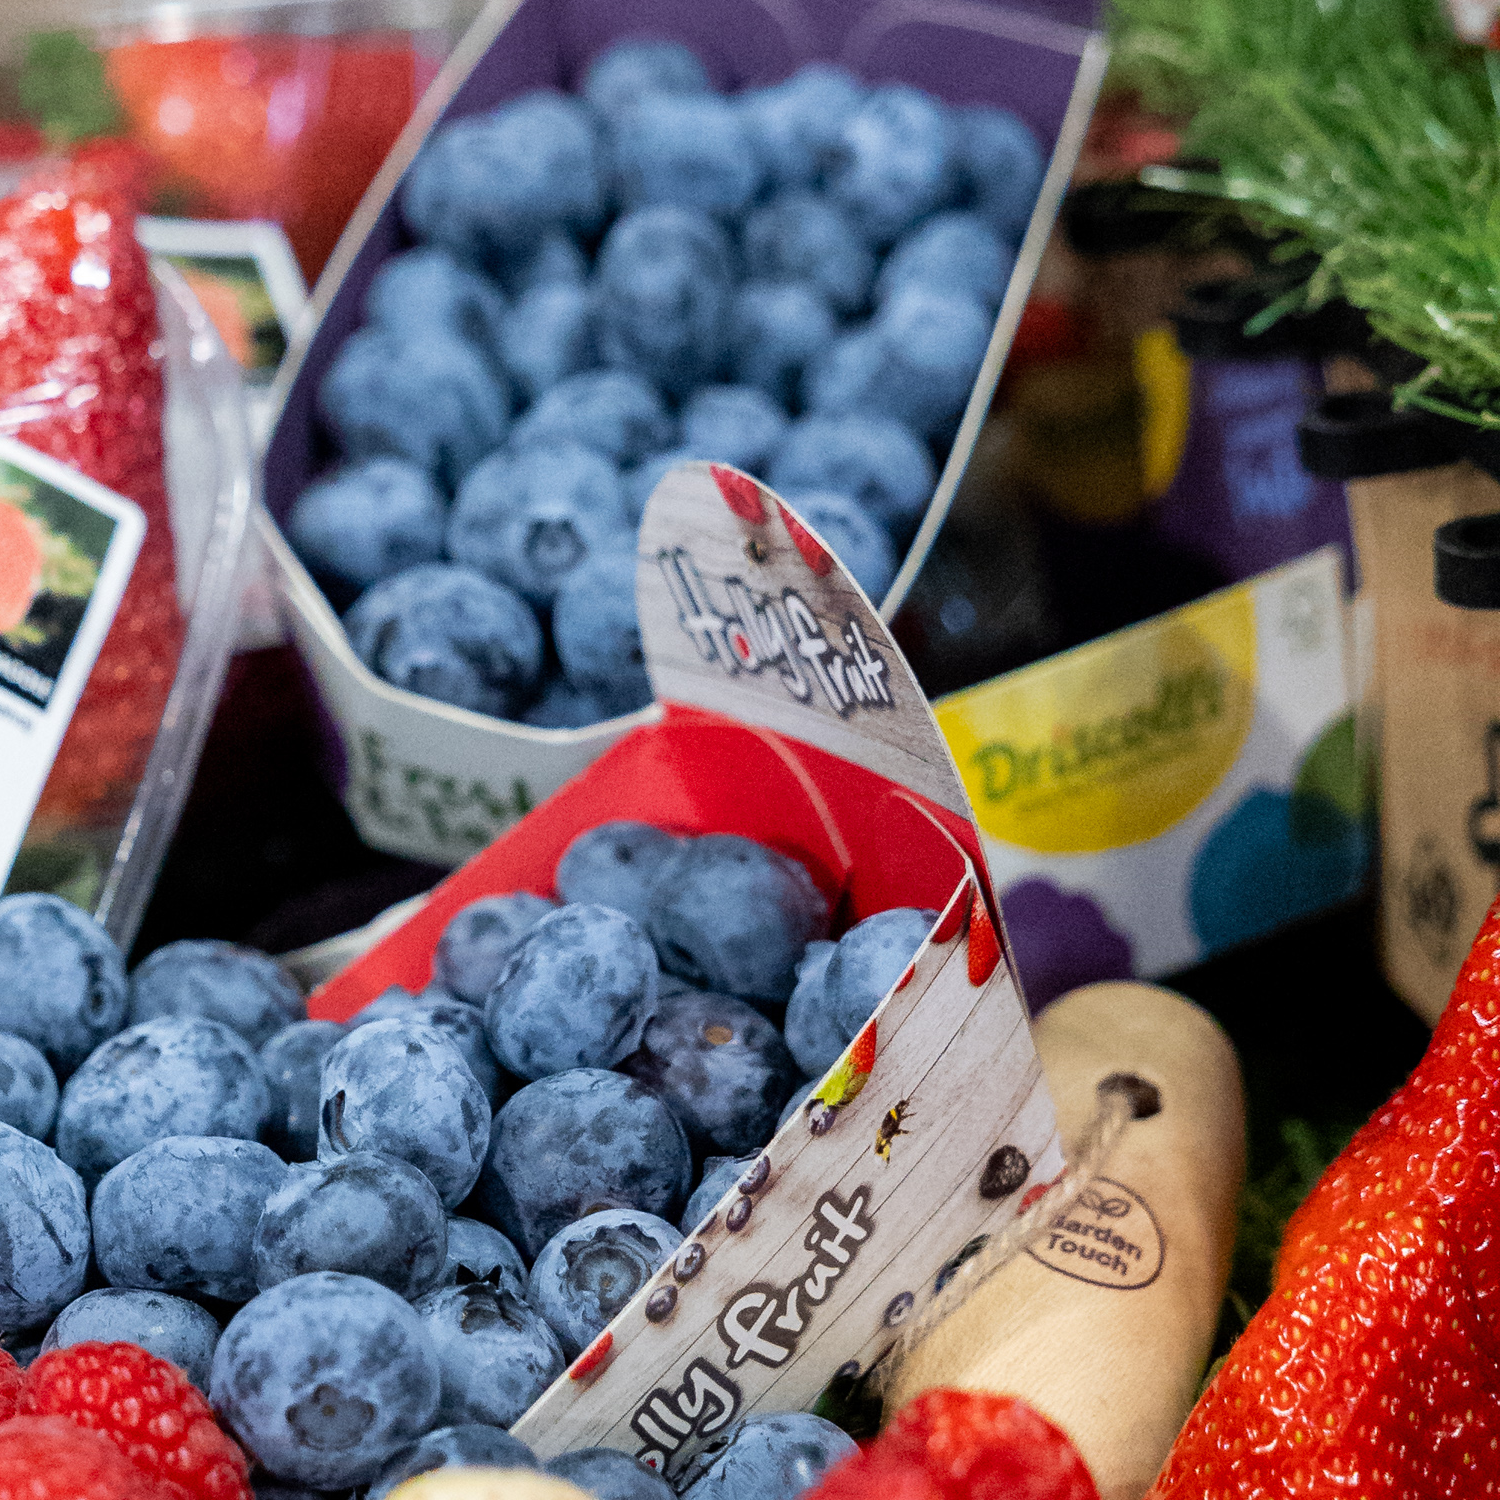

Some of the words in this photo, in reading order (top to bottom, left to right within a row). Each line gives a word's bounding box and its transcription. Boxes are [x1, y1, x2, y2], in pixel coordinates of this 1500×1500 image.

[657, 543, 815, 706] Holly
[783, 586, 896, 720] fruit
[632, 1356, 743, 1475] olly
[716, 1184, 875, 1370] fruit
[1047, 1232, 1129, 1277] Touch
